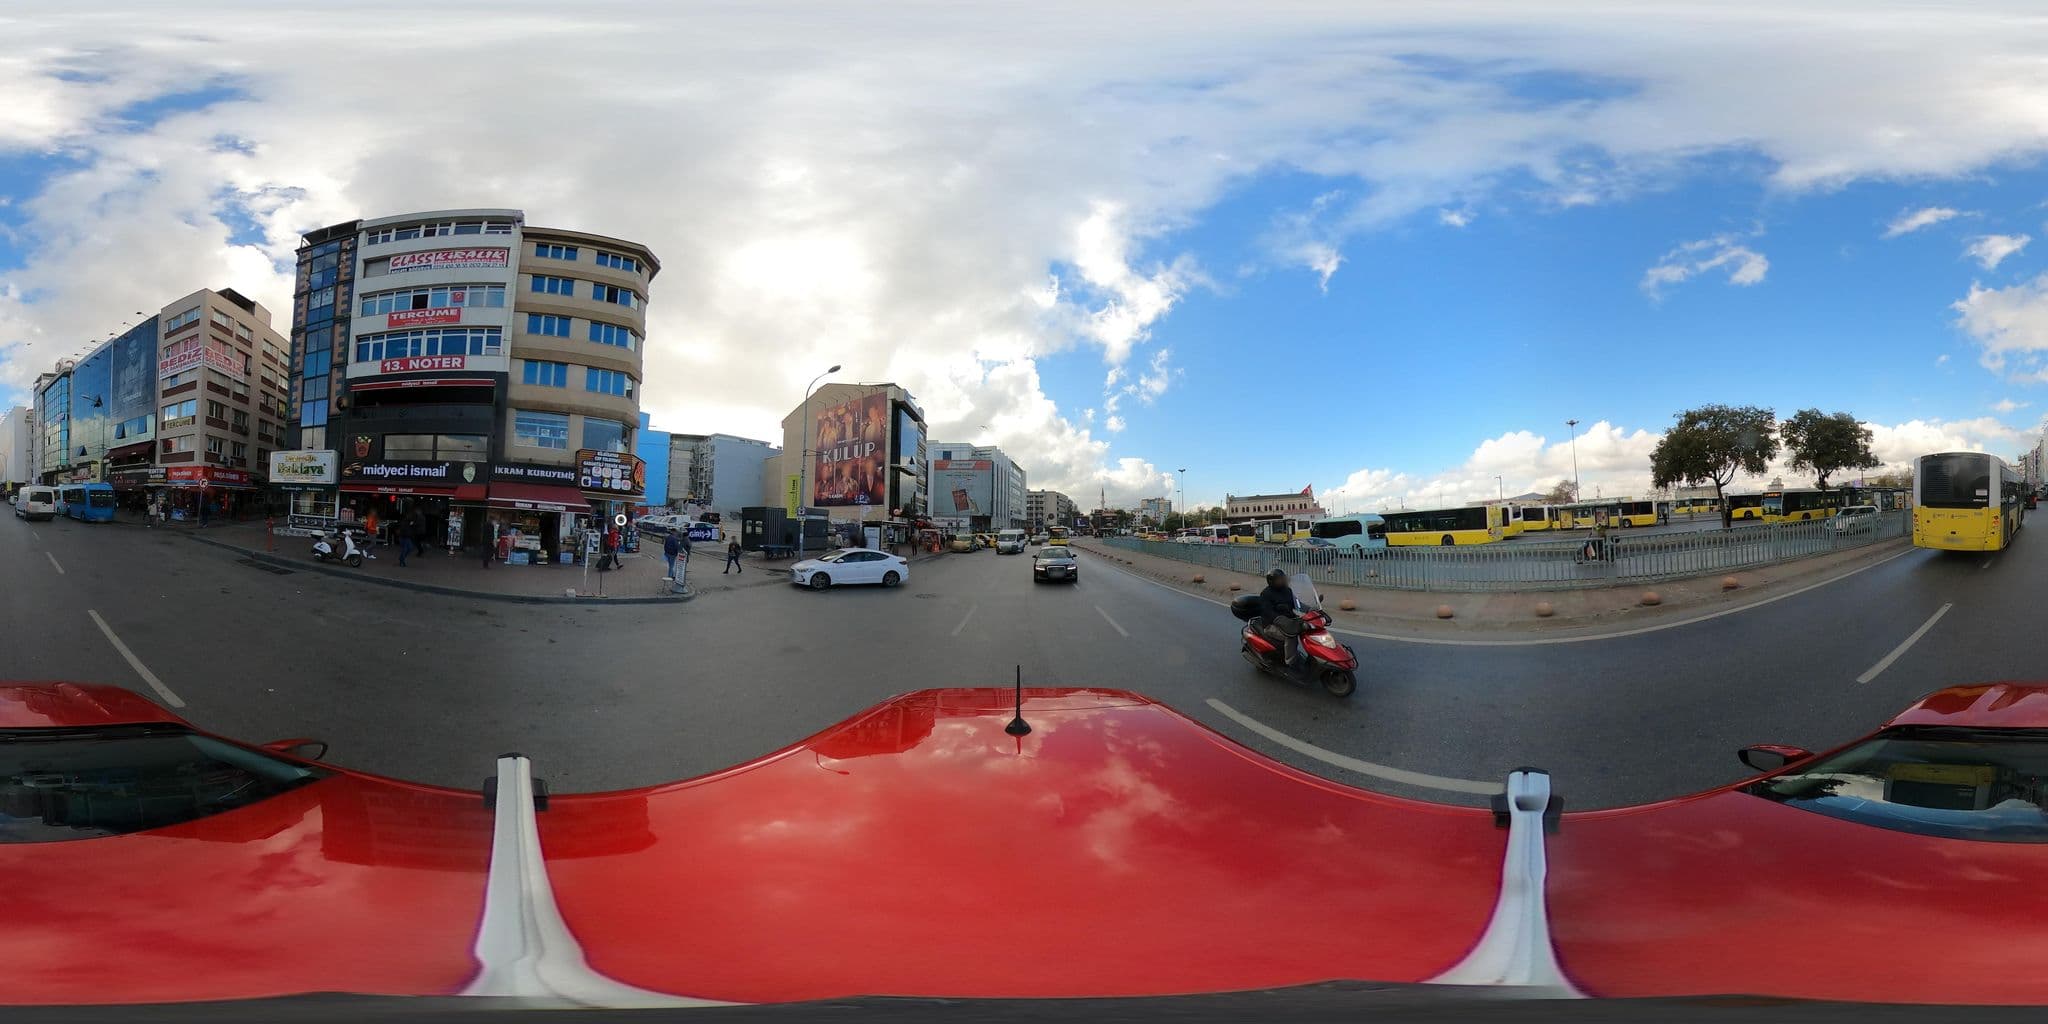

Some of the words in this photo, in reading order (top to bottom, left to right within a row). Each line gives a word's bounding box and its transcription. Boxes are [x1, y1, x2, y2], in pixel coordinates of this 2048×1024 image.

[391, 253, 433, 267] GLASS
[384, 361, 404, 372] 13.
[409, 357, 462, 369] NOTER
[823, 441, 875, 463] KULÜP
[363, 464, 408, 478] midyeci
[410, 465, 446, 477] ismail
[495, 466, 524, 475] İKRAM
